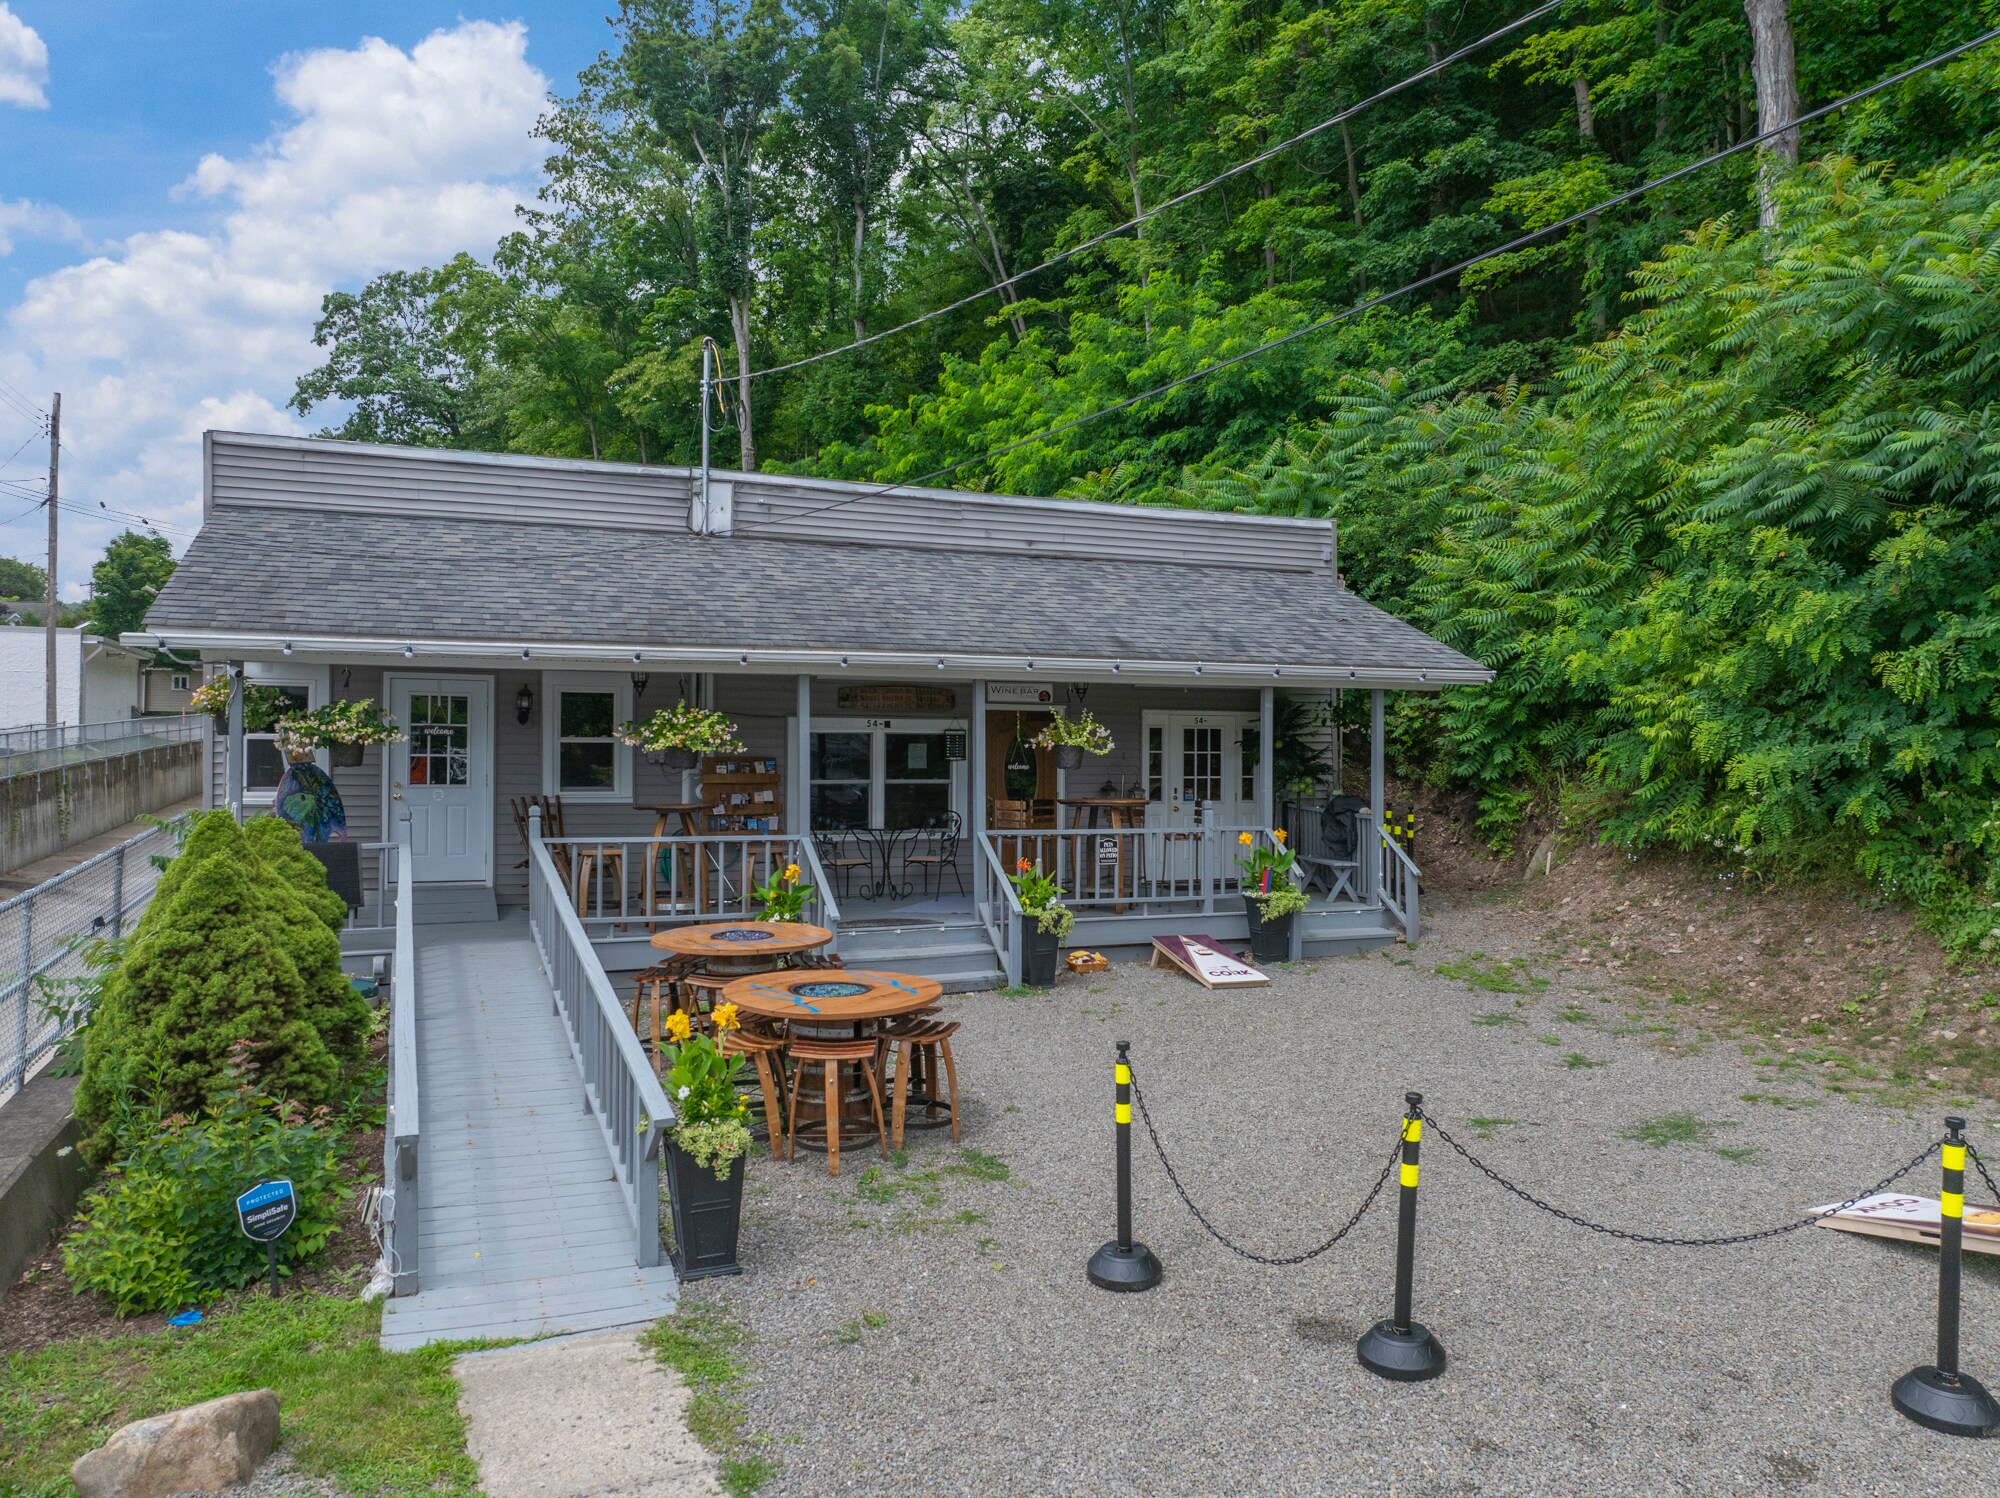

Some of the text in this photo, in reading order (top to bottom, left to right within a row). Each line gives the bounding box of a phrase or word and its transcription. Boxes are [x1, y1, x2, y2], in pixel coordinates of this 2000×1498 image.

[1020, 687, 1040, 695] BAR
[424, 726, 454, 735] welcome
[1007, 761, 1030, 771] welcome
[246, 1189, 284, 1205] PROTECTED
[246, 1203, 289, 1224] SimpliSafe
